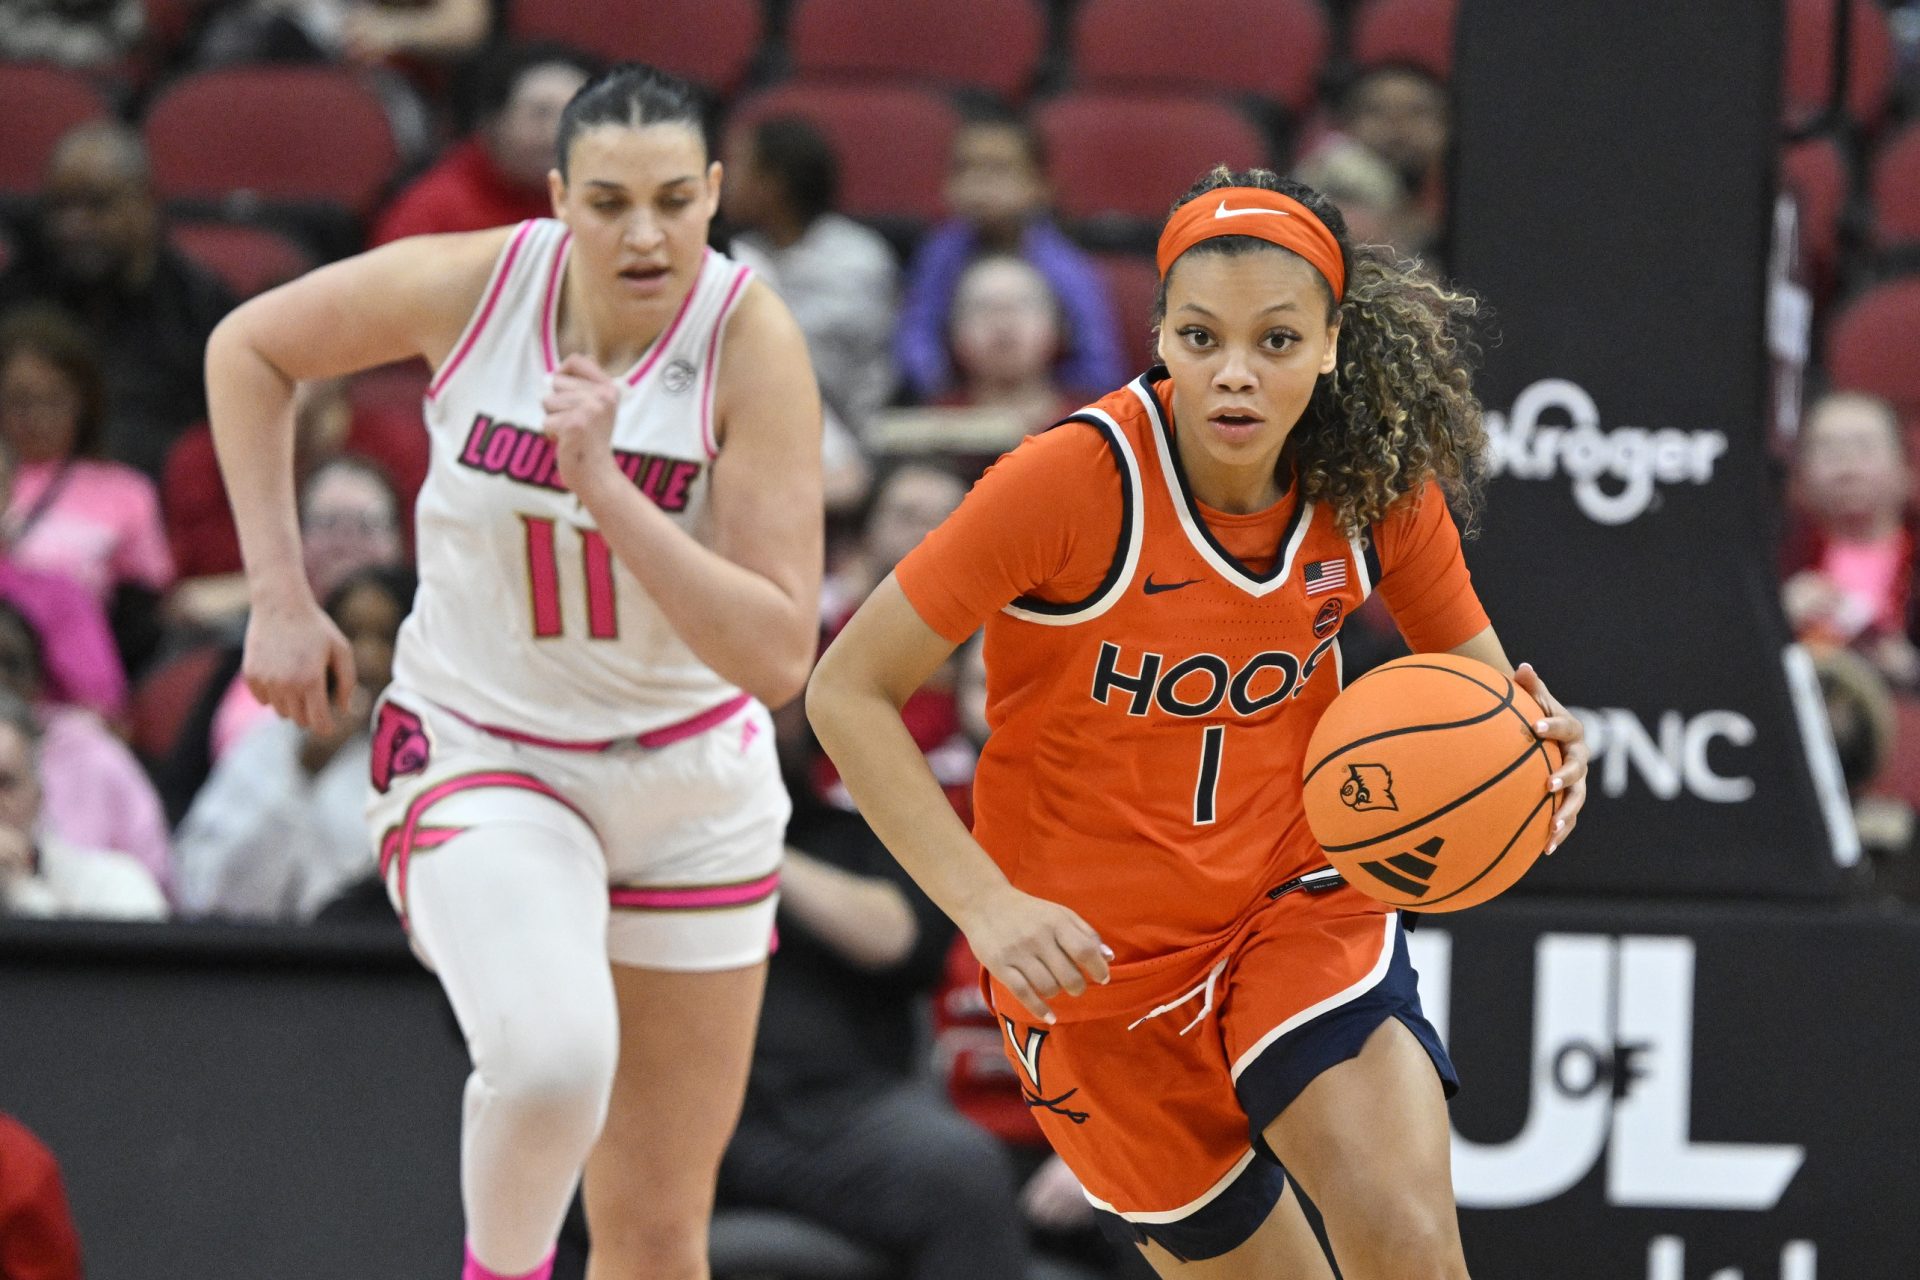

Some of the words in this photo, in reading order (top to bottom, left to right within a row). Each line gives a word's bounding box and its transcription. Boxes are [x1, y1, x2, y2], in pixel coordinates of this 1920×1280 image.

[1483, 378, 1729, 524] Kroger
[516, 513, 619, 640] 11
[1193, 724, 1226, 826] 1
[1552, 1037, 1656, 1105] OF
